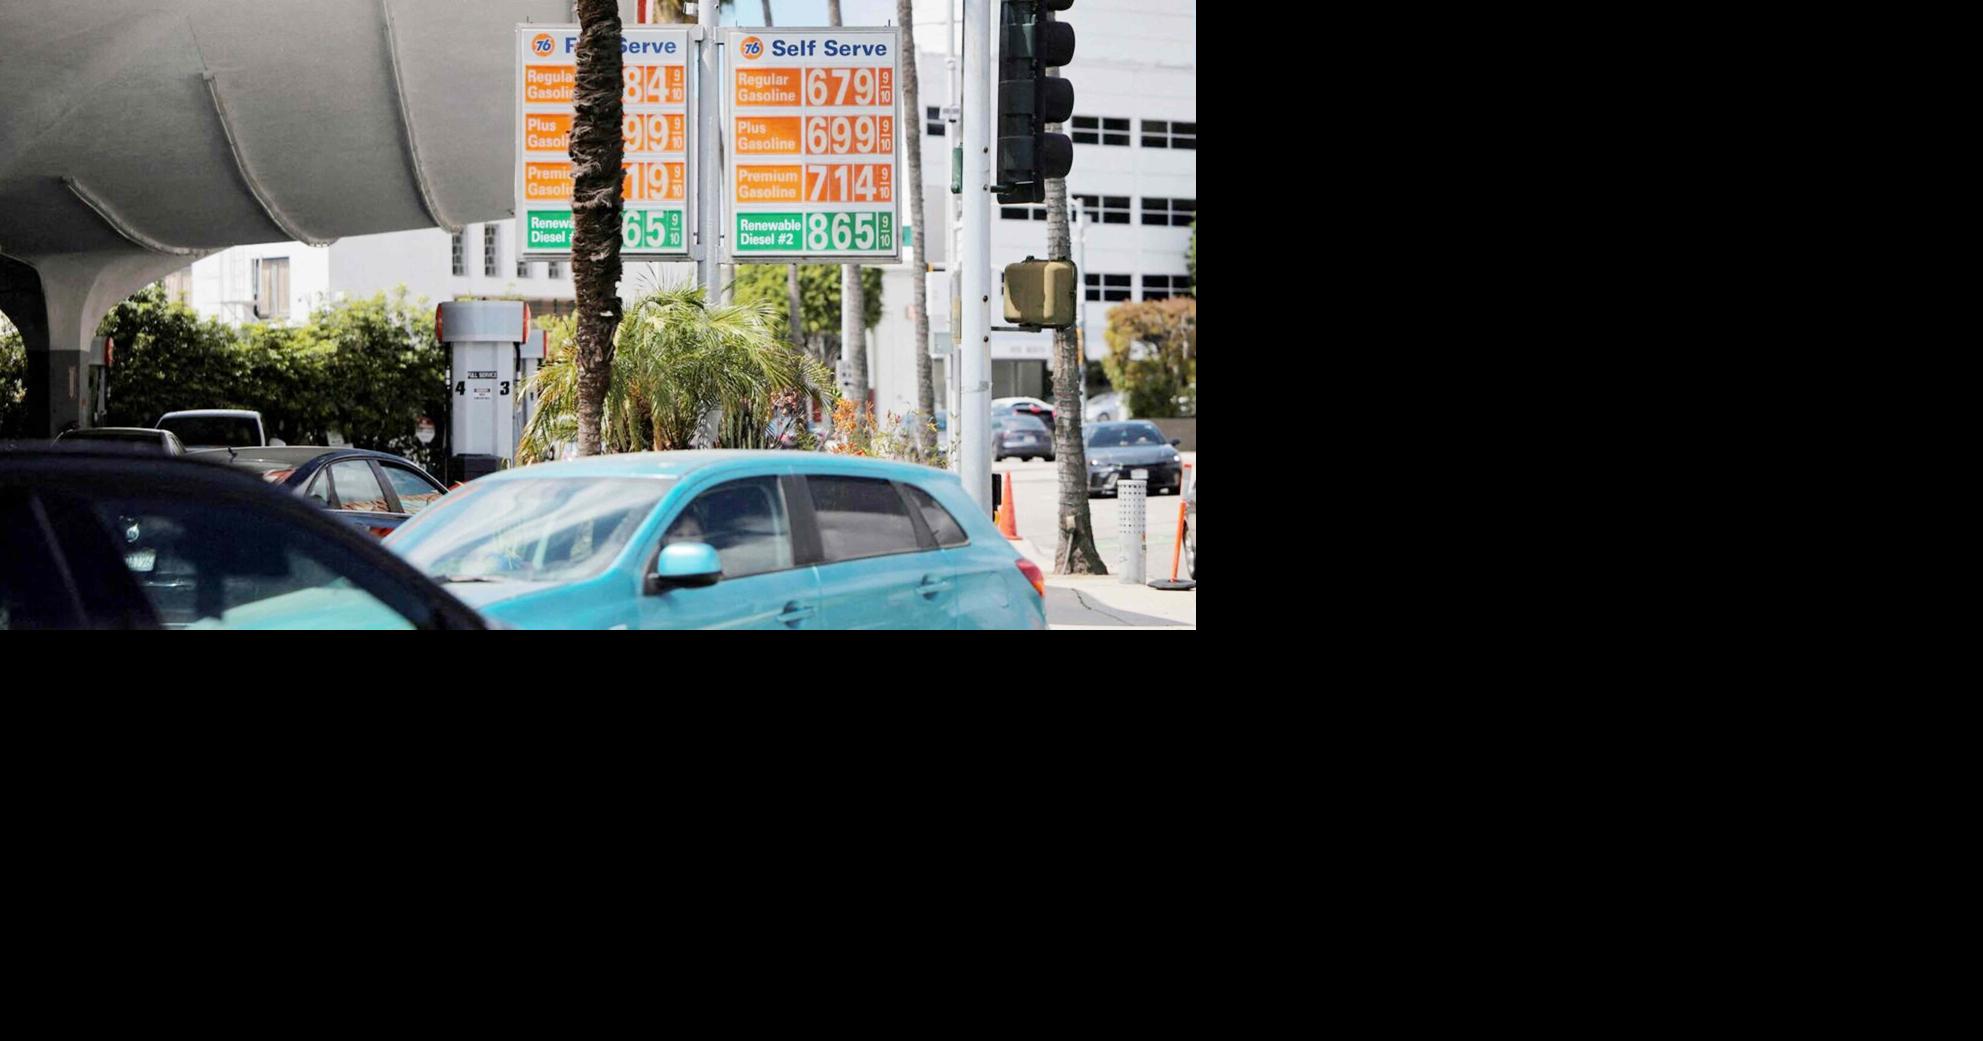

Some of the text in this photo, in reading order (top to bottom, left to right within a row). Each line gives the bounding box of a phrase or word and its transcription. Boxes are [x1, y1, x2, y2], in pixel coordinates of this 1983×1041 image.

[536, 39, 551, 52] 76
[744, 42, 760, 54] 76
[772, 40, 887, 56] Self Serve
[528, 70, 574, 86] Regula
[624, 66, 670, 102] 84
[738, 72, 789, 88] Regular
[882, 72, 888, 83] 9
[808, 68, 874, 106] 679
[672, 88, 682, 100] 10
[738, 90, 796, 102] Gasoline
[880, 90, 890, 102] 10
[528, 118, 556, 132] Plus
[738, 121, 766, 134] Plus
[882, 120, 889, 132] 9
[622, 114, 669, 151] 99
[808, 116, 876, 154] 699
[528, 134, 570, 148] Gasoli
[738, 137, 796, 150] Gasoline
[880, 139, 890, 151] 10
[738, 170, 798, 182] Premium
[882, 167, 888, 180] 9
[624, 163, 668, 200] 19
[808, 166, 876, 200] 714
[672, 185, 682, 196] 10
[738, 186, 796, 198] Gasoline
[880, 187, 890, 199] 10
[672, 214, 678, 226] 9
[740, 220, 802, 231] Renewable
[882, 216, 888, 228] 9
[622, 210, 665, 247] 65
[808, 213, 874, 250] 865
[531, 230, 566, 242] Diesel
[670, 232, 680, 244] 10
[740, 234, 794, 245] Diesel #2
[880, 234, 890, 247] 10
[455, 381, 466, 396] 4
[500, 381, 510, 396] 3
